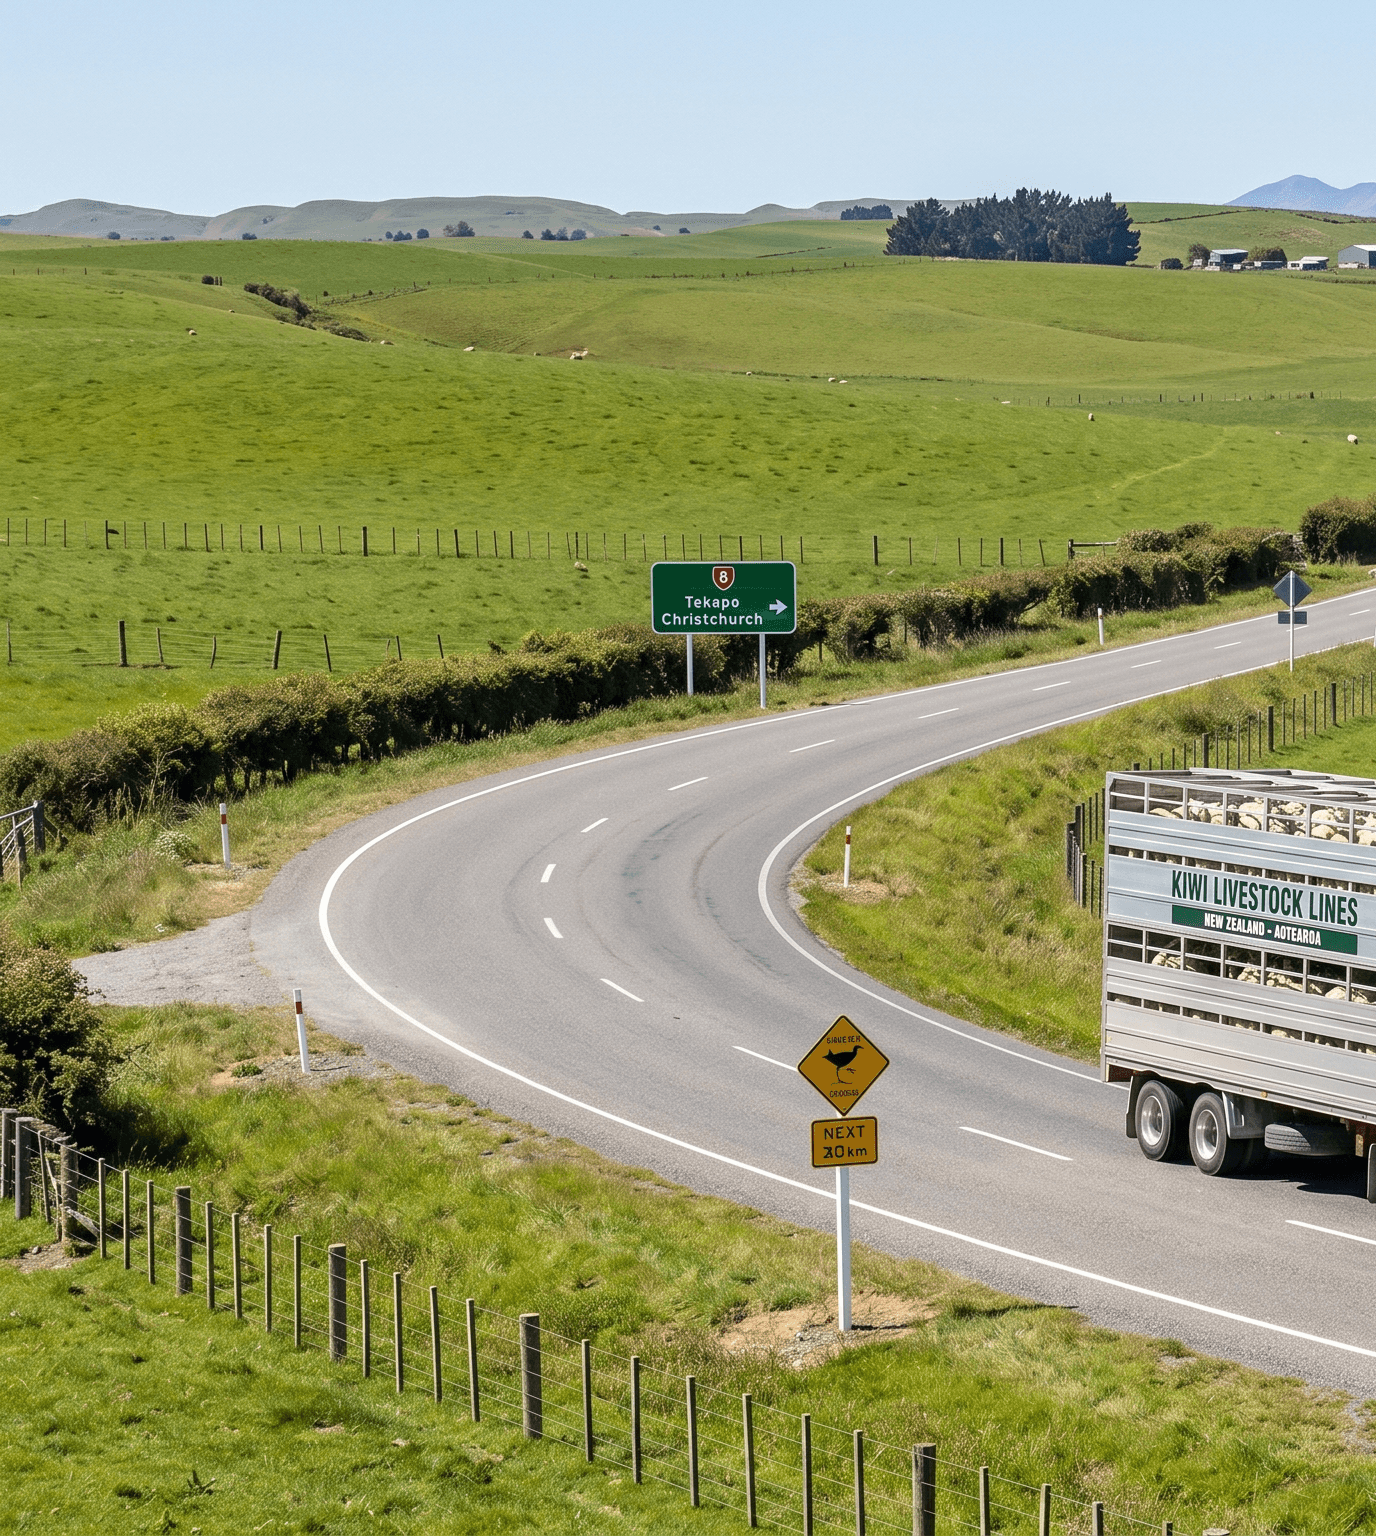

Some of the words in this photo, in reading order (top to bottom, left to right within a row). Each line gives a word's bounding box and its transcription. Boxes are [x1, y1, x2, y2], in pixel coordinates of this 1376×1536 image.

[719, 570, 728, 584] 8
[685, 595, 740, 611] Tekapo
[661, 612, 763, 626] Christchurch
[1171, 869, 1208, 903] KIWI
[1213, 876, 1304, 919] LIVESTOCK
[1309, 891, 1358, 927] LINES
[1204, 912, 1224, 930] NEW
[1225, 915, 1265, 937] ZEALAND
[1273, 924, 1322, 946] AOTEAROA
[824, 1124, 865, 1141] NEXT
